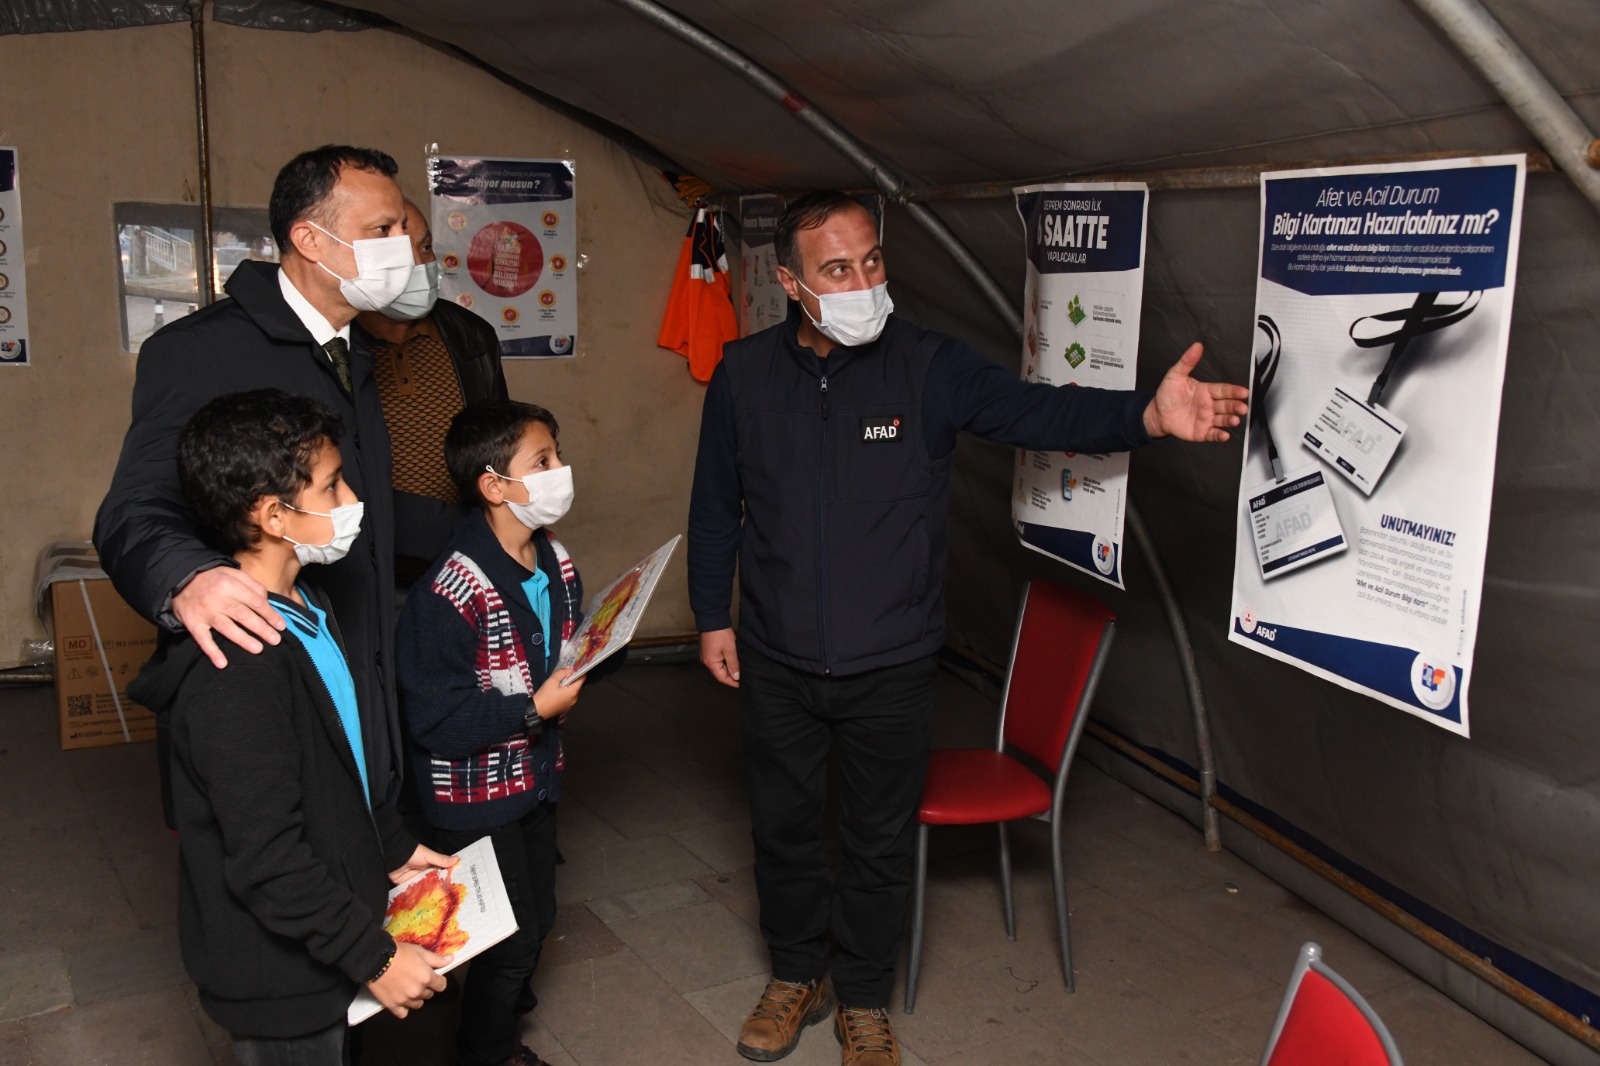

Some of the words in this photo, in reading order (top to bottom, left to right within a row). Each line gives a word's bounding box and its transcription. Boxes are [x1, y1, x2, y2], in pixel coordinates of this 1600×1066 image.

[1315, 187, 1345, 207] Afet
[1346, 190, 1362, 206] ve
[1363, 185, 1391, 206] Acil
[1389, 185, 1440, 205] Durum
[1062, 200, 1091, 211] SONRASI
[1043, 214, 1110, 249] SAATTE
[1272, 211, 1302, 241] Bilgi
[1300, 213, 1363, 235] Kartınızı
[1362, 209, 1461, 235] Hazırladınız
[1459, 208, 1500, 235] mı?
[1046, 251, 1087, 264] YAPILACAKLAR
[864, 425, 897, 440] AFAD
[1380, 513, 1457, 547] UNUTMAYINIZ!
[1255, 625, 1276, 642] AFAD
[68, 640, 87, 649] MD
